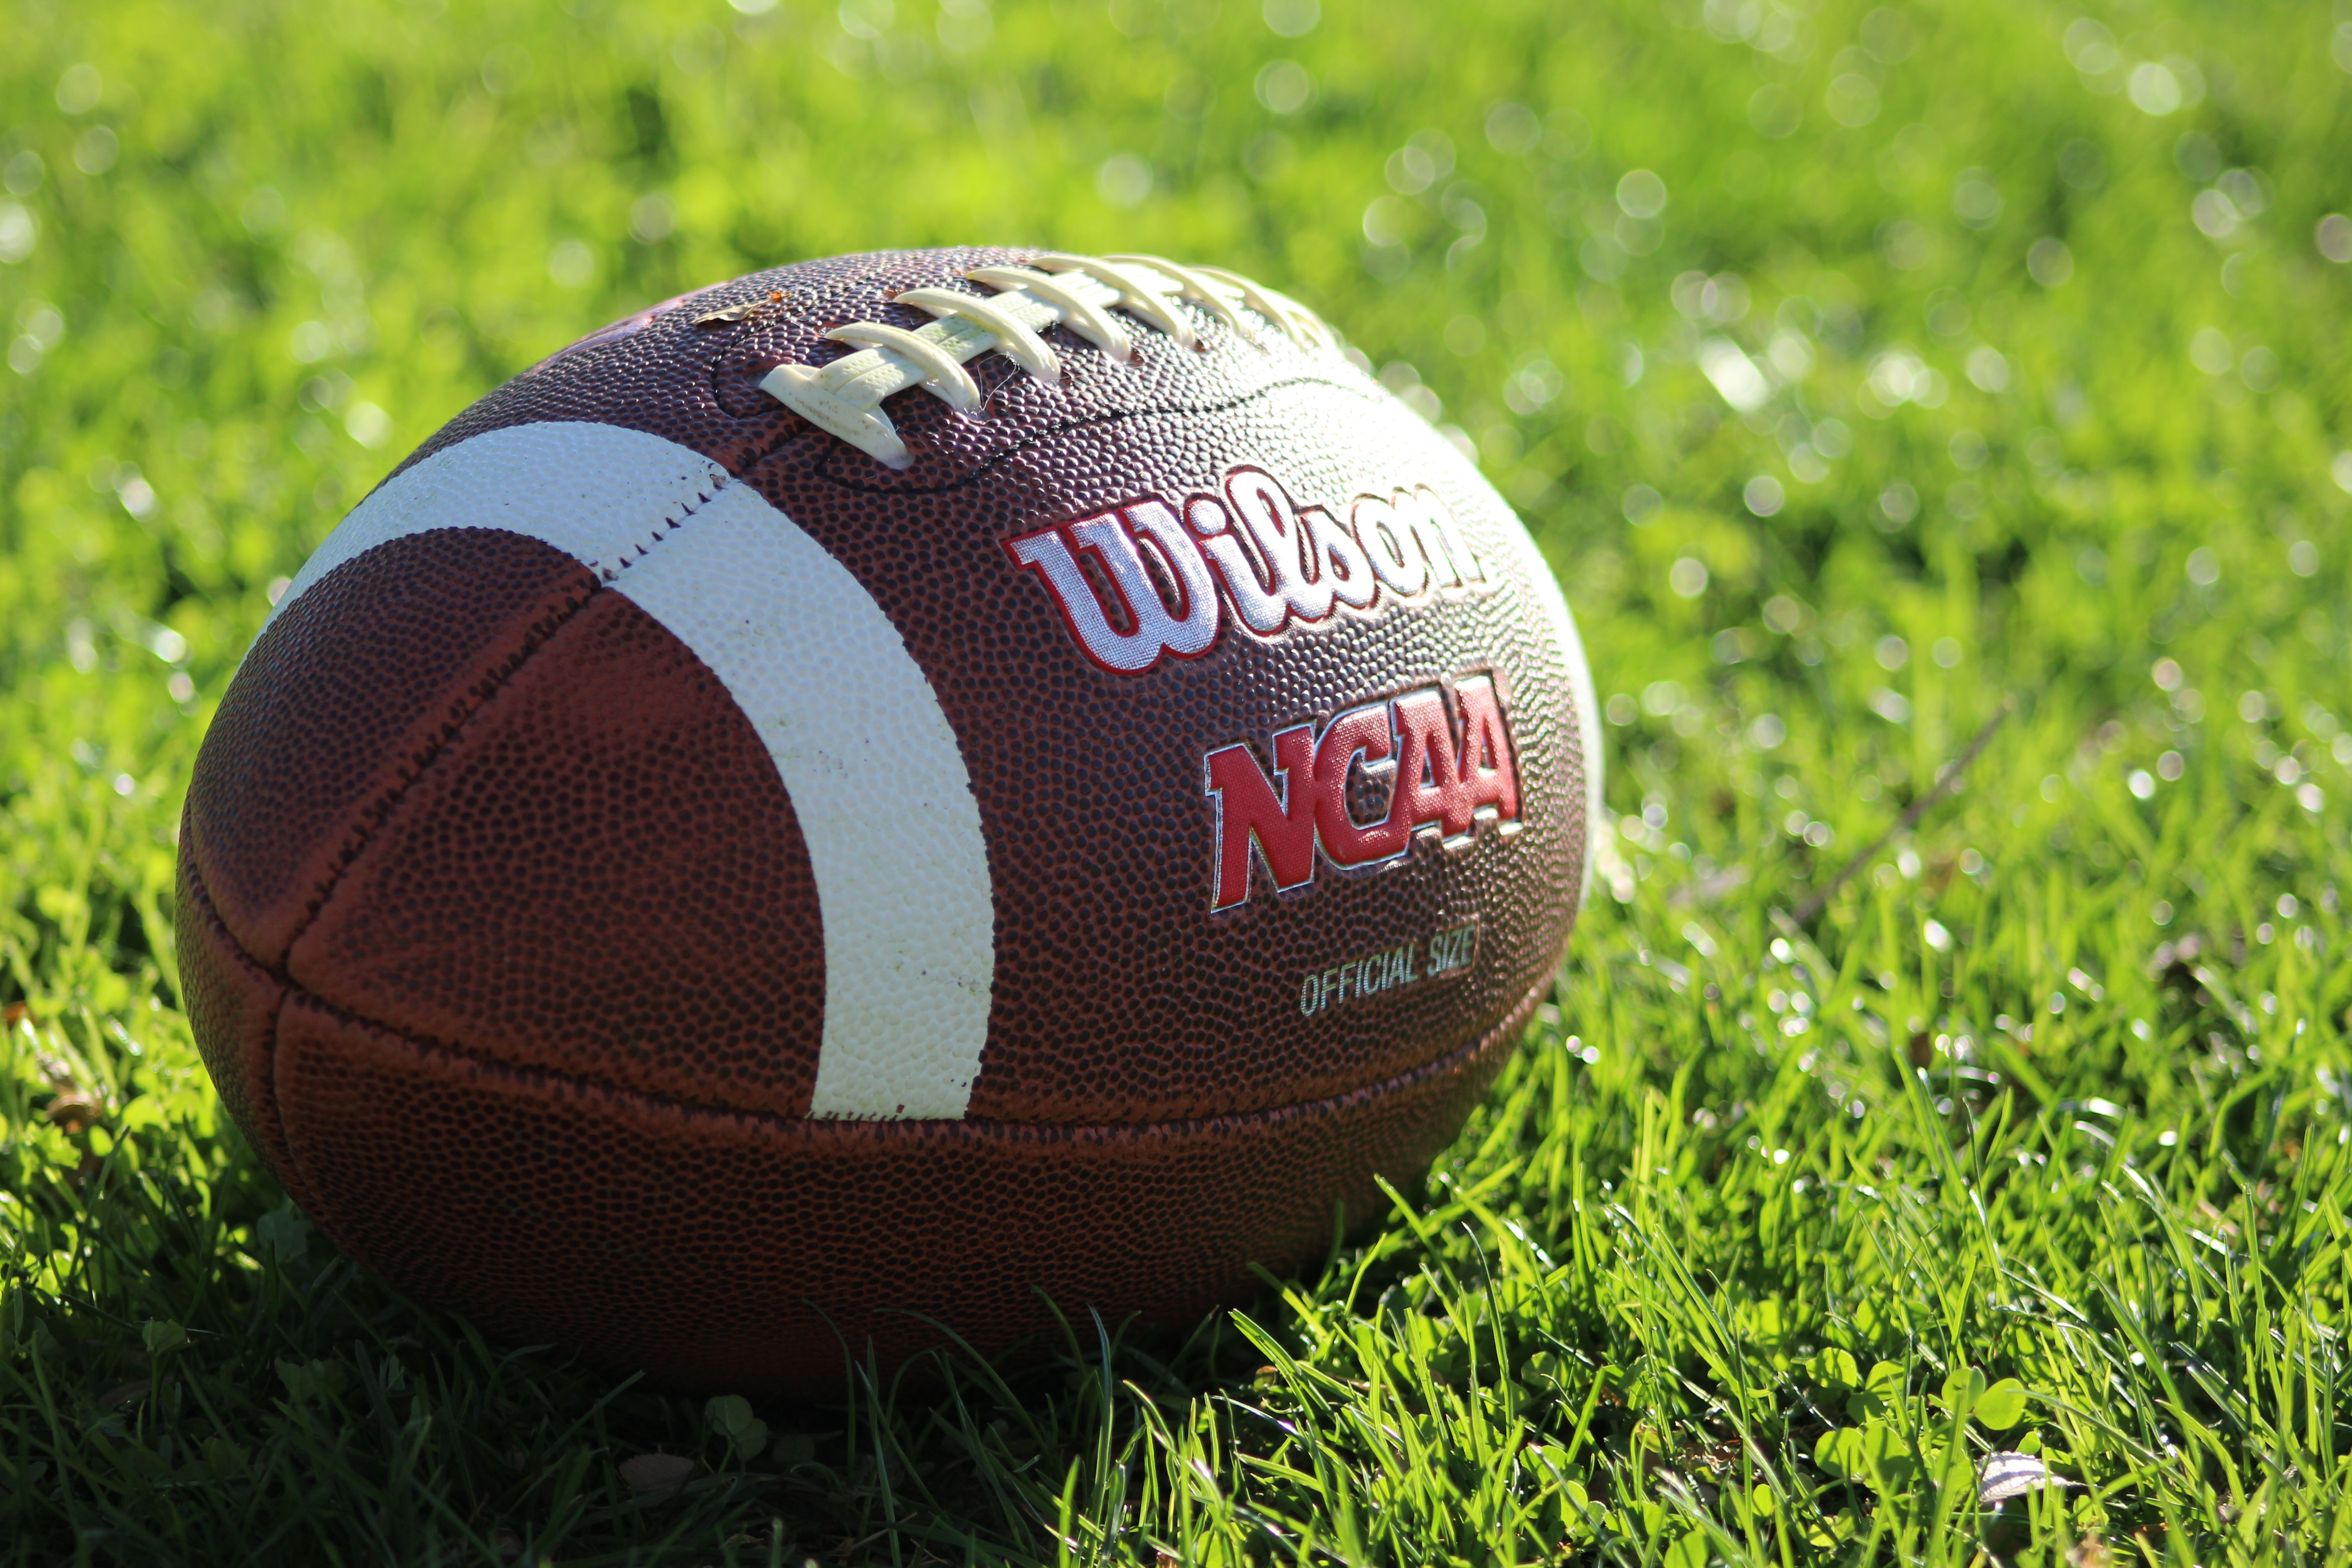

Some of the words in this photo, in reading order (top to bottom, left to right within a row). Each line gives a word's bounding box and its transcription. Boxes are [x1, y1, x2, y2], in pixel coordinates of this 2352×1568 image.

[1006, 465, 1486, 675] Wilson
[1205, 671, 1523, 913] NCAA
[1300, 943, 1418, 1016] OFFICIAL
[1427, 924, 1475, 976] SIZE
